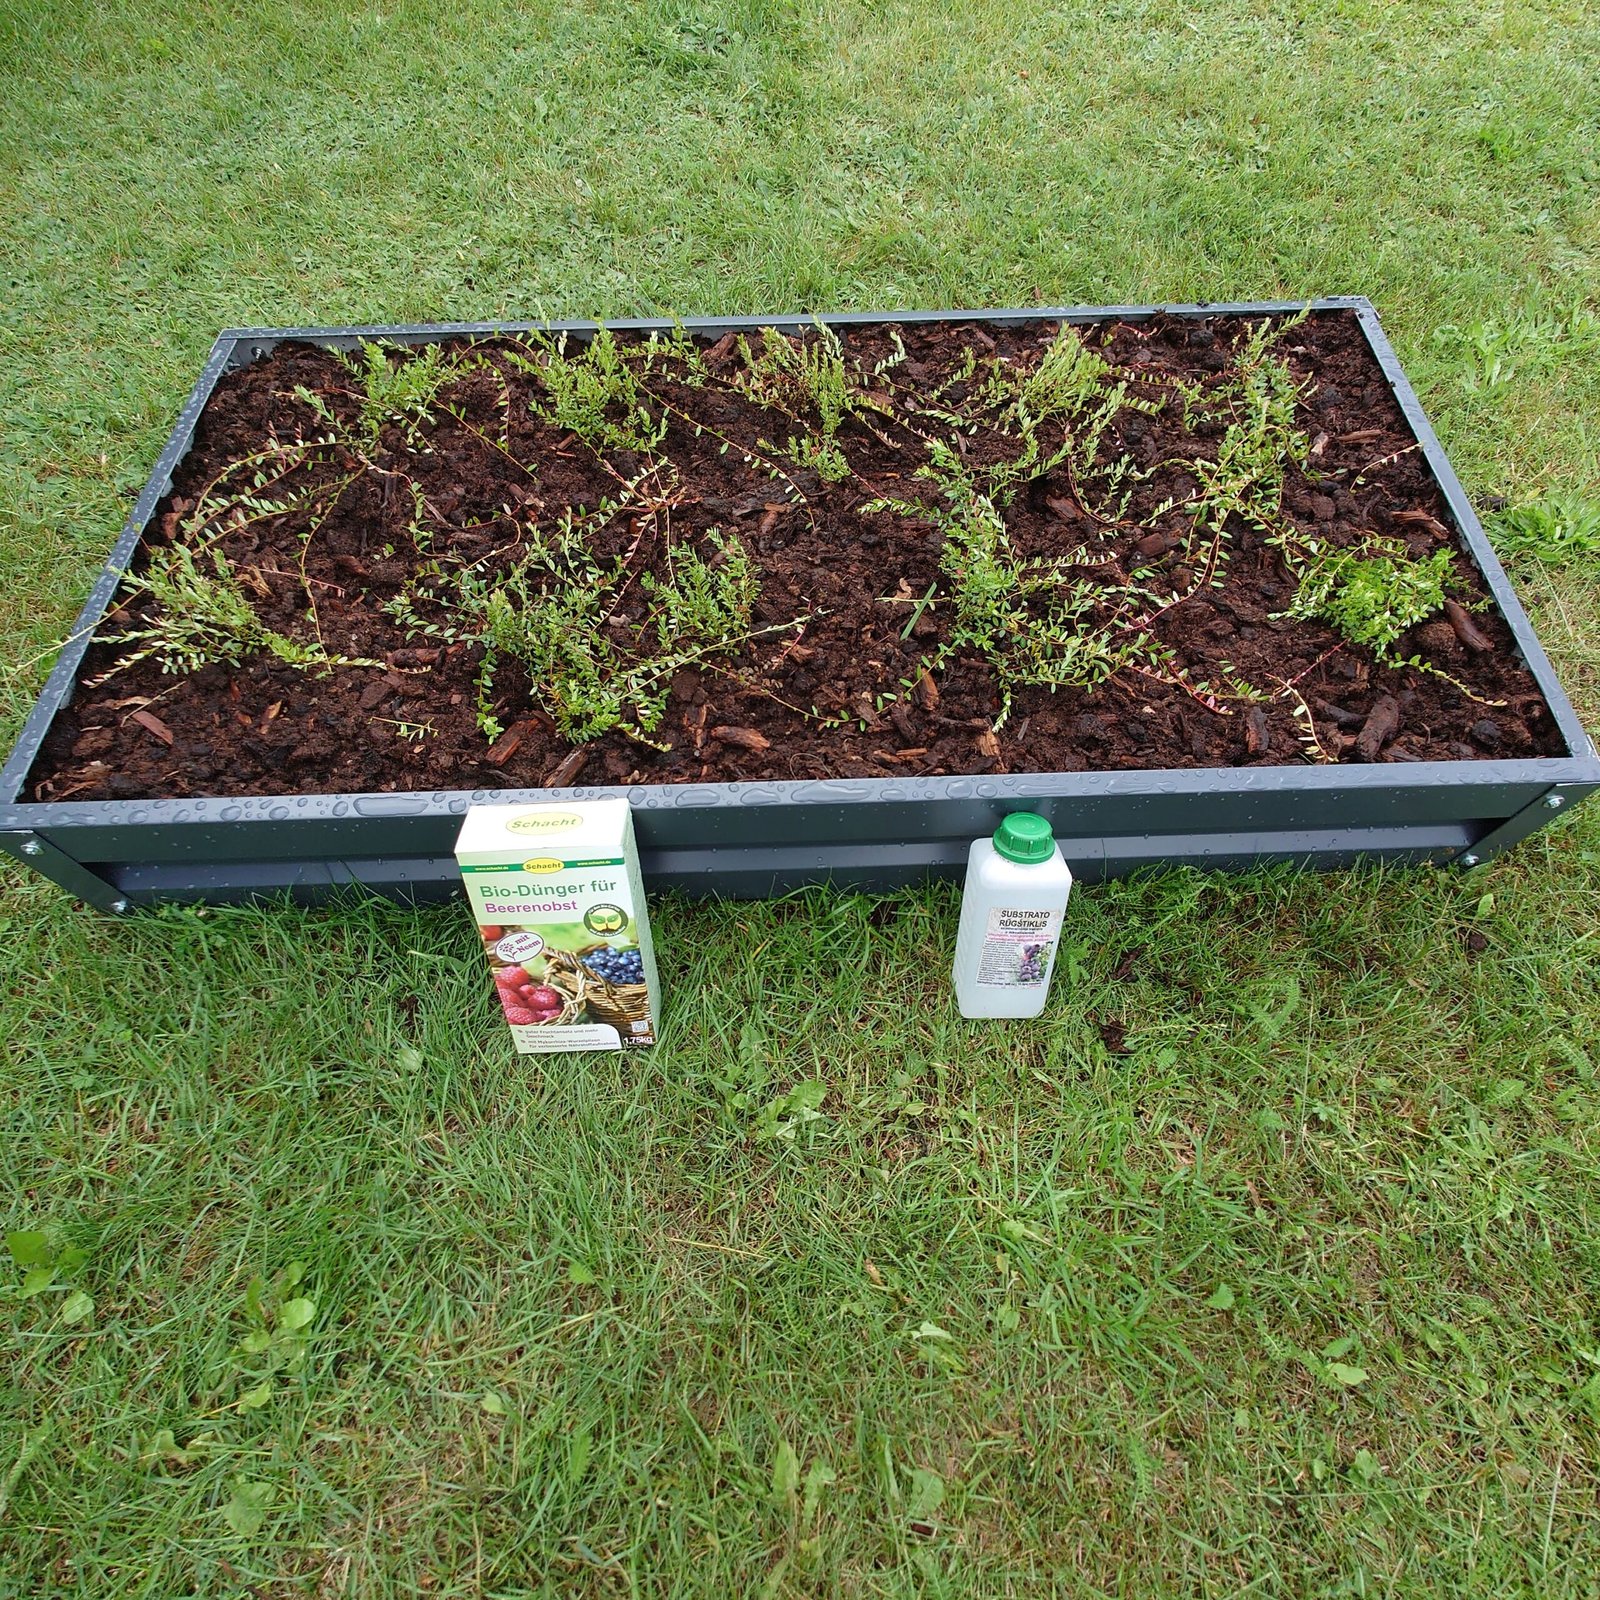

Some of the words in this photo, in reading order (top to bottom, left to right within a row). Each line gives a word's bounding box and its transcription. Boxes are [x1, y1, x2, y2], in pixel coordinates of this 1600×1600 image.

[512, 818, 577, 829] Schacht
[526, 861, 562, 870] Schacht
[480, 883, 585, 898] Bio-Dünger
[590, 880, 617, 892] für
[485, 900, 578, 913] Beerenobst
[1001, 910, 1050, 918] SUBSTRATO
[999, 919, 1047, 927] RŪGŠTIKLIS
[515, 934, 530, 945] mit
[518, 939, 541, 954] Neem
